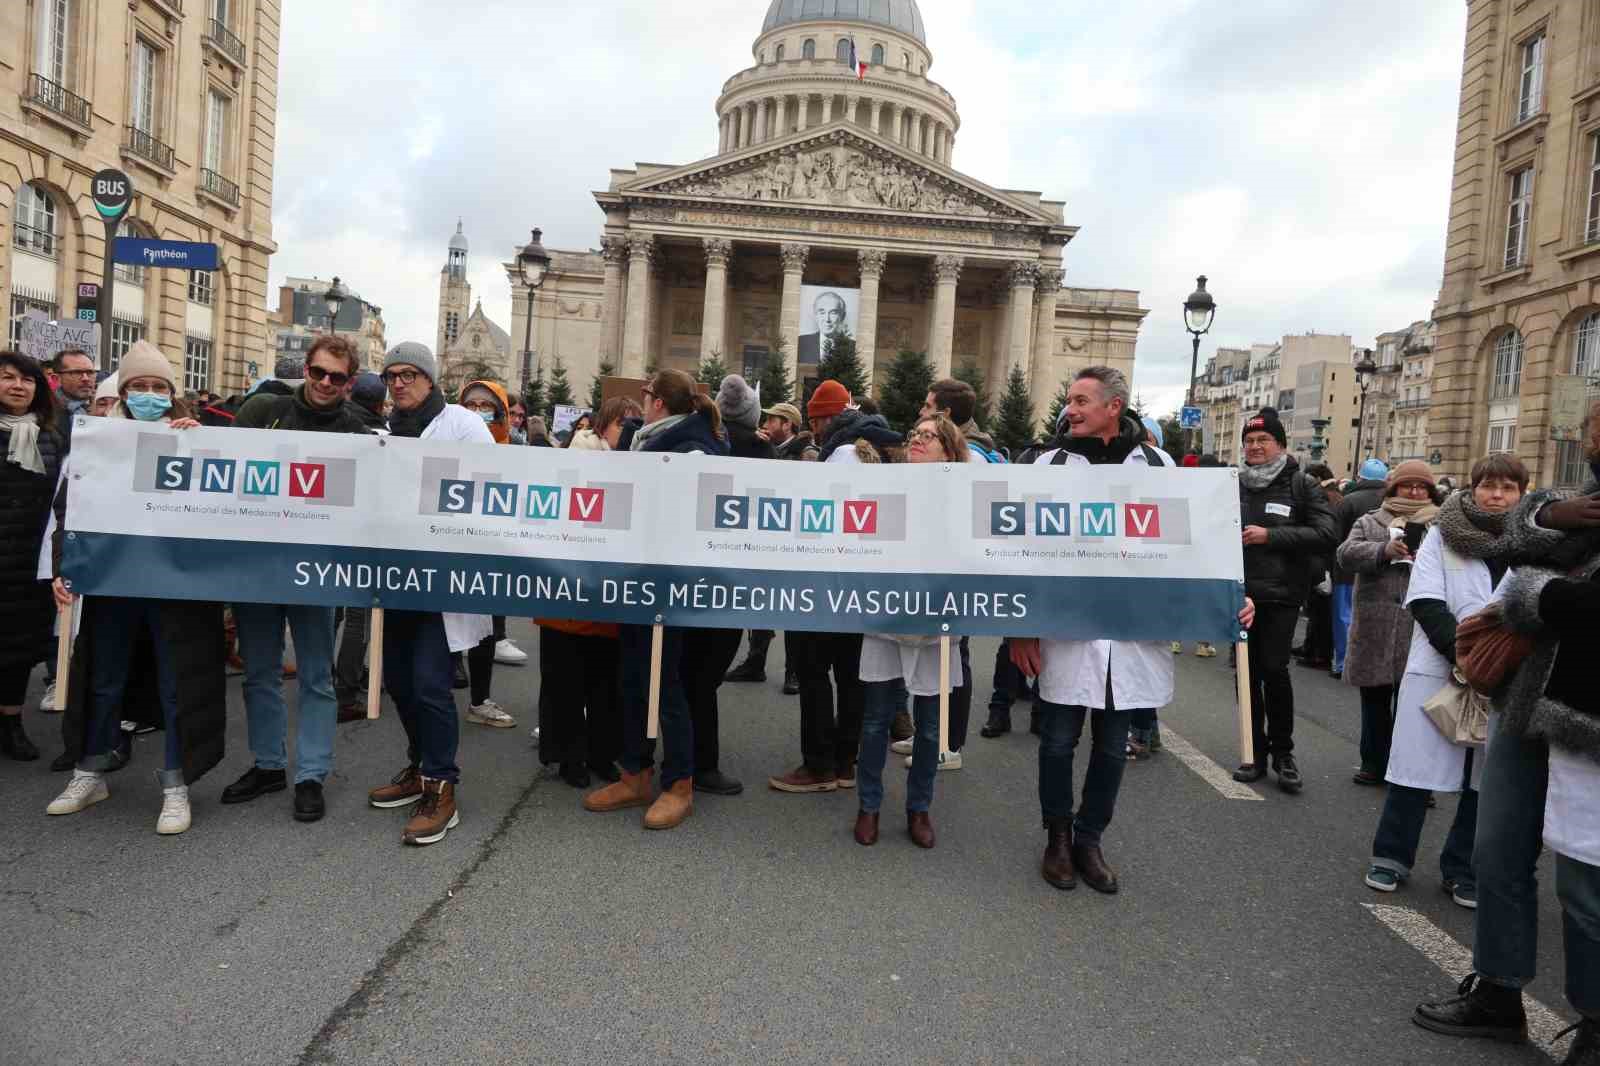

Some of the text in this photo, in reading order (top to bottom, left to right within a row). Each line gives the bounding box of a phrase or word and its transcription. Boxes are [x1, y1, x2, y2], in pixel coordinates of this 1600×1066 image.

[97, 180, 125, 196] BUS
[144, 247, 188, 261] Panthéon
[81, 310, 95, 321] 89
[63, 328, 90, 344] AVC
[163, 460, 320, 495] SNMV
[446, 483, 600, 518] SNMV
[145, 502, 182, 513] Syndicat
[184, 504, 219, 514] National
[221, 506, 236, 514] des
[283, 509, 331, 520] Vasculaires
[722, 499, 873, 531] SNMV
[998, 505, 1154, 535] SNMV
[430, 525, 464, 536] Syndicat
[466, 528, 501, 538] National
[503, 530, 517, 539] des
[562, 533, 607, 544] Vasculaires
[707, 541, 742, 552] Syndicat
[744, 543, 779, 553] National
[780, 544, 794, 553] des
[837, 546, 883, 556] Vasculaires
[985, 549, 1020, 560] Syndicat
[1022, 549, 1058, 560] National
[1060, 551, 1074, 560] des
[294, 561, 1027, 618] SYNDICAT NATIONAL DES MÉDECINS VASCULAIRES
